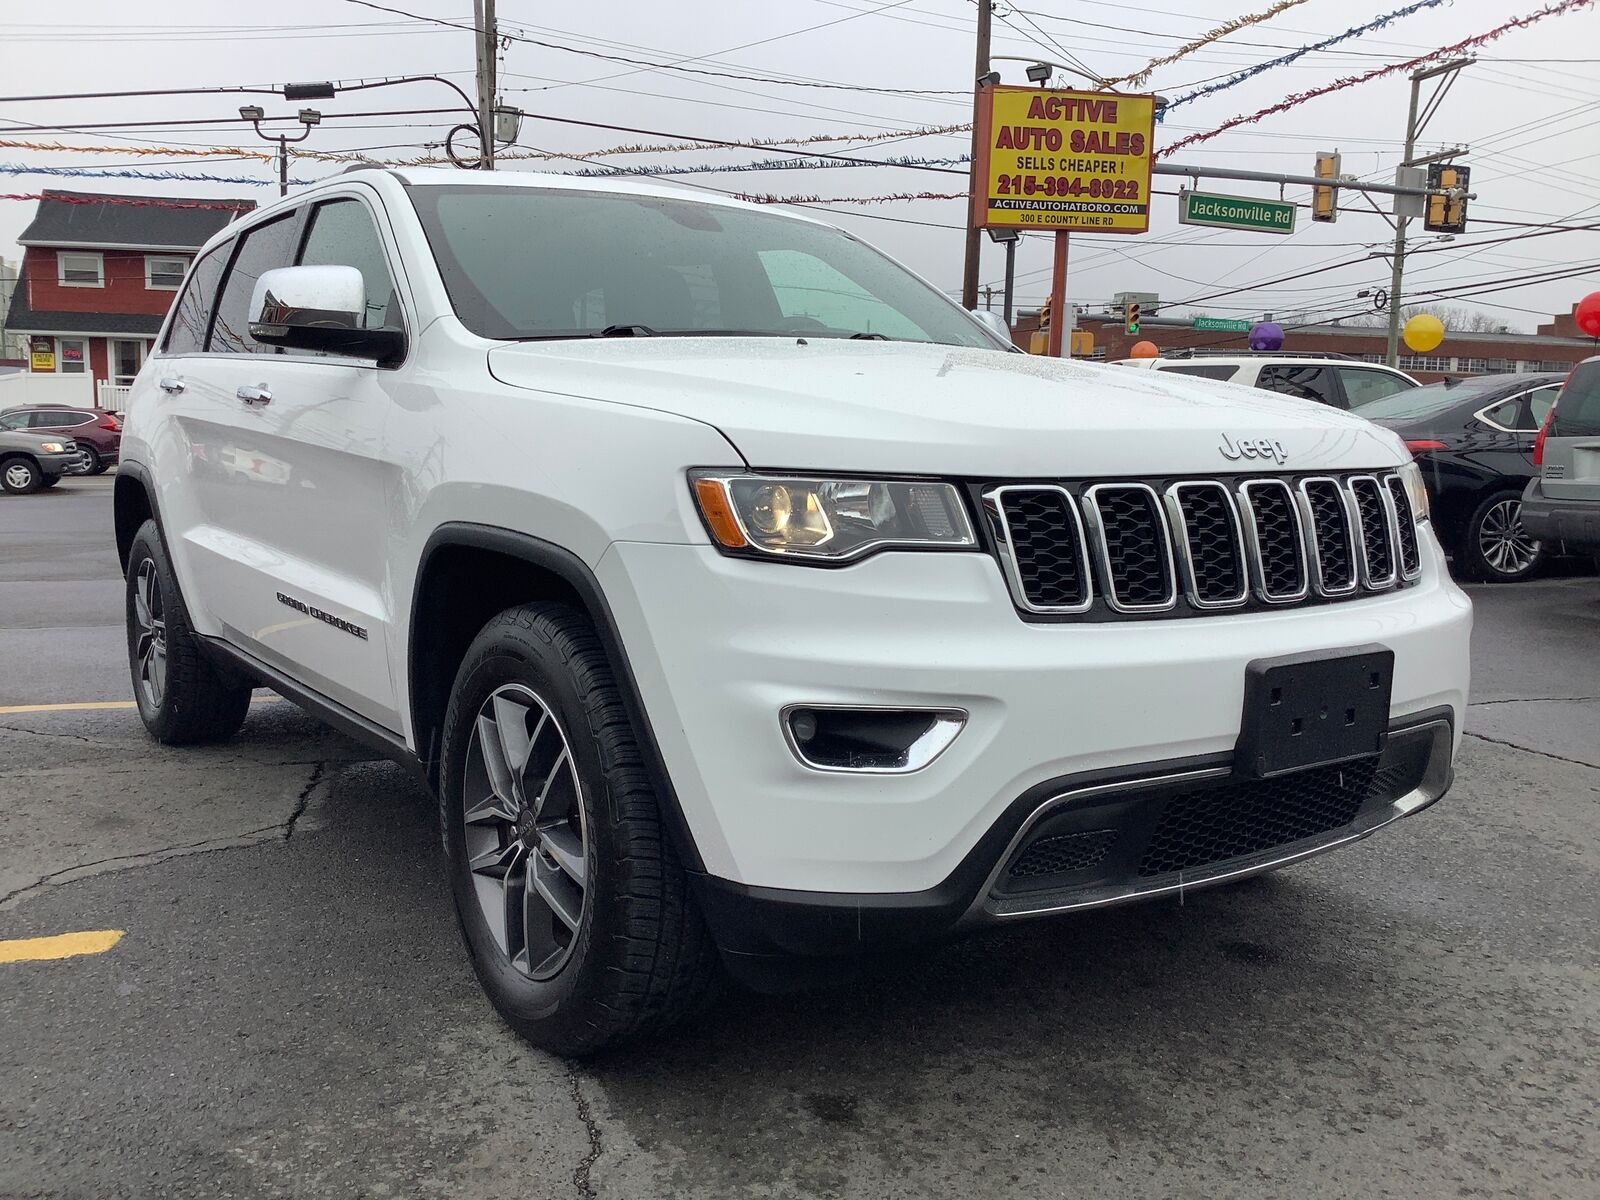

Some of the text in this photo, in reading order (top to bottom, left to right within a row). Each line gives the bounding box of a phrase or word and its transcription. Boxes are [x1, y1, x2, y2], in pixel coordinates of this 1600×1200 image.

[1027, 96, 1118, 124] ACTIVE
[996, 125, 1145, 156] AUTO SALES
[1016, 156, 1055, 171] SELLS
[1060, 159, 1117, 174] CHEAPER
[997, 174, 1139, 200] 215-394-8922
[994, 199, 1139, 214] ACTIVEAUTOHATBORO.COM
[1191, 201, 1291, 223] Jacksonville Rd
[1020, 213, 1114, 226] 300 E COUNTY LINE RD
[1198, 319, 1247, 330] Jacksonville Rd
[1218, 432, 1288, 465] Jeep
[309, 606, 368, 641] CHEROKEE
